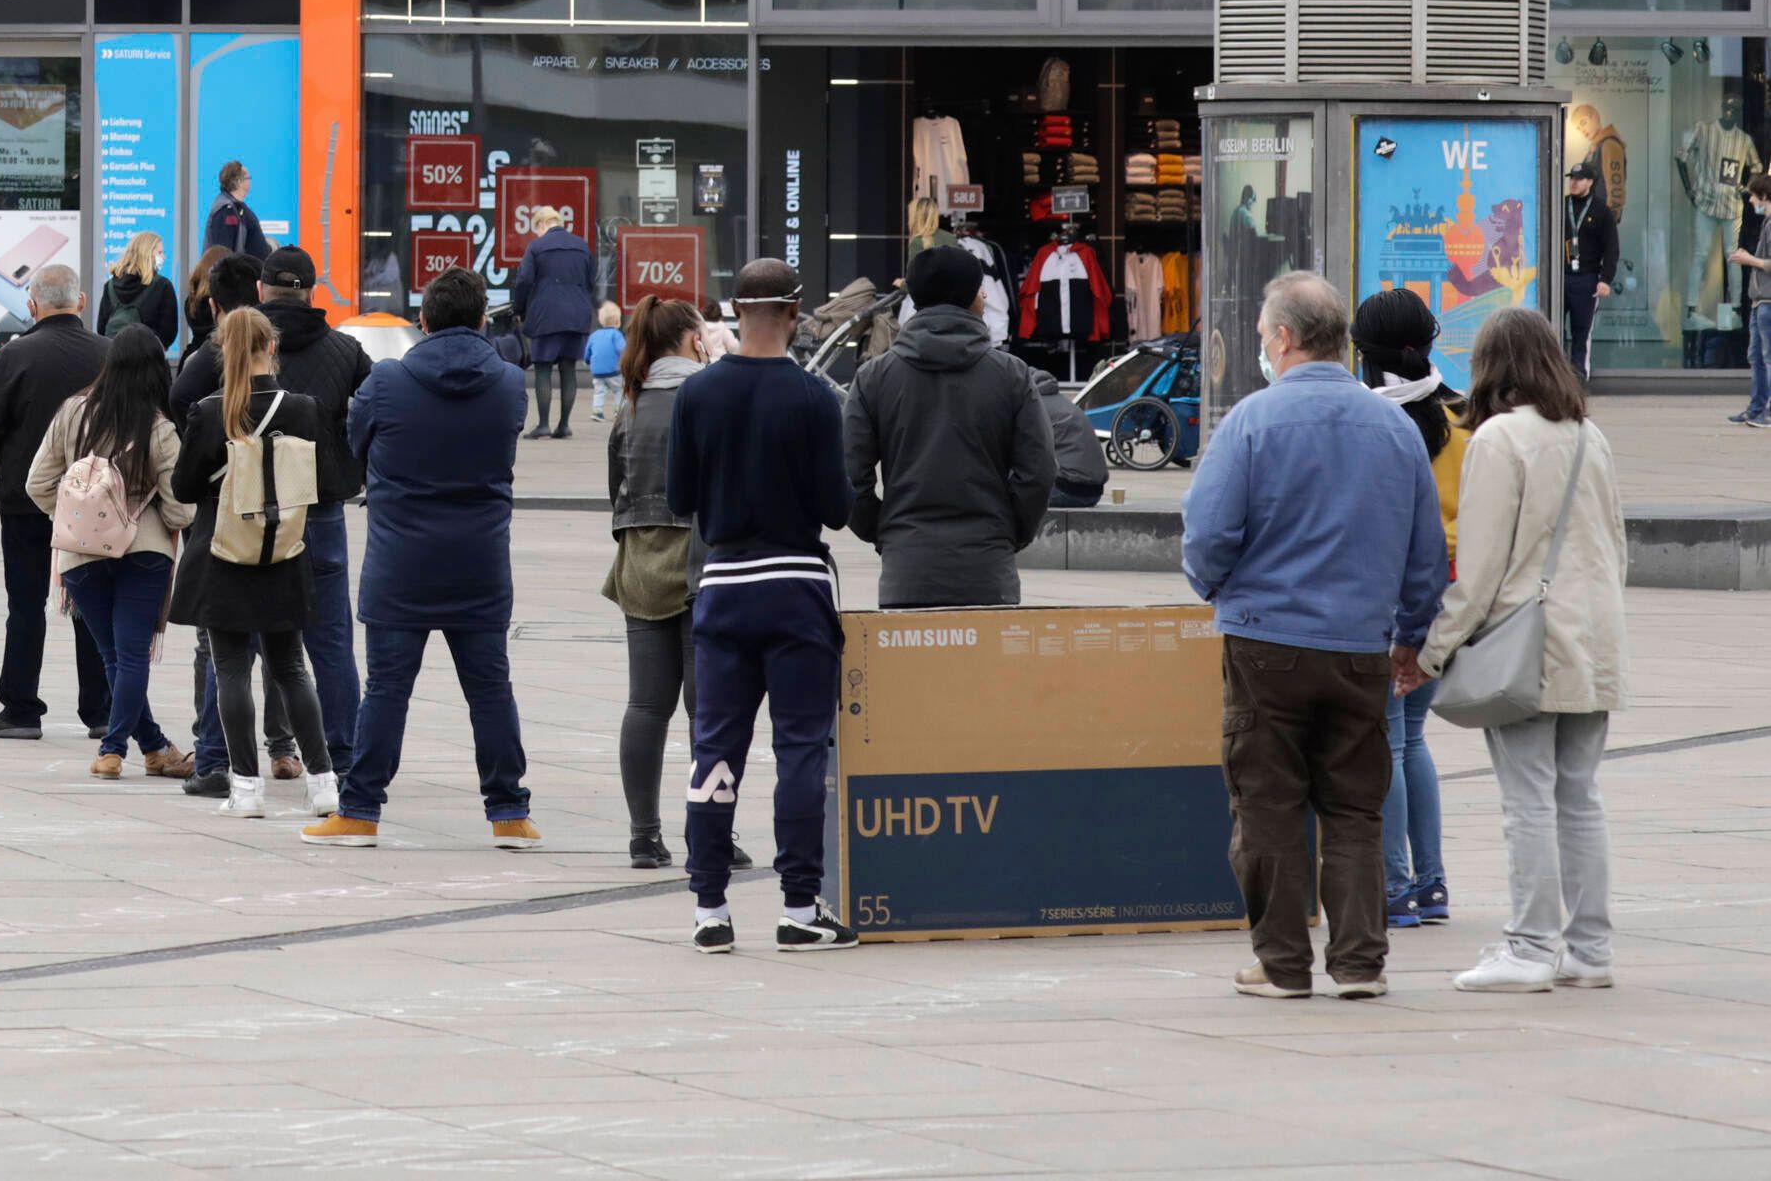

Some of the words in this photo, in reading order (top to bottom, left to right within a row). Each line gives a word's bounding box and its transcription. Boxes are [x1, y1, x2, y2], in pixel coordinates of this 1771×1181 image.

[114, 49, 143, 59] SATURN
[145, 49, 172, 59] Service
[532, 56, 579, 68] APPAREL
[605, 57, 659, 69] SNEAKER
[687, 58, 771, 71] ACCESSORES
[1251, 138, 1295, 153] BERLIN
[1442, 140, 1488, 170] WE
[422, 165, 463, 184] 50%
[786, 150, 800, 212] ONLINE
[1611, 161, 1621, 209] SQUA
[18, 198, 61, 210] SATURN
[953, 192, 976, 204] sale
[514, 205, 575, 236] se
[786, 217, 800, 229] &
[786, 234, 800, 270] ORE
[425, 255, 459, 272] 30%
[636, 262, 684, 284] 70%
[878, 628, 978, 648] SAMSUNG
[856, 797, 942, 838] UHD
[946, 794, 999, 835] TV
[858, 895, 891, 926] 55
[1048, 904, 1117, 920] SERIES/SÉRIE
[1122, 903, 1162, 918] NU7100
[1162, 901, 1236, 917] CLASS/CLASSE
